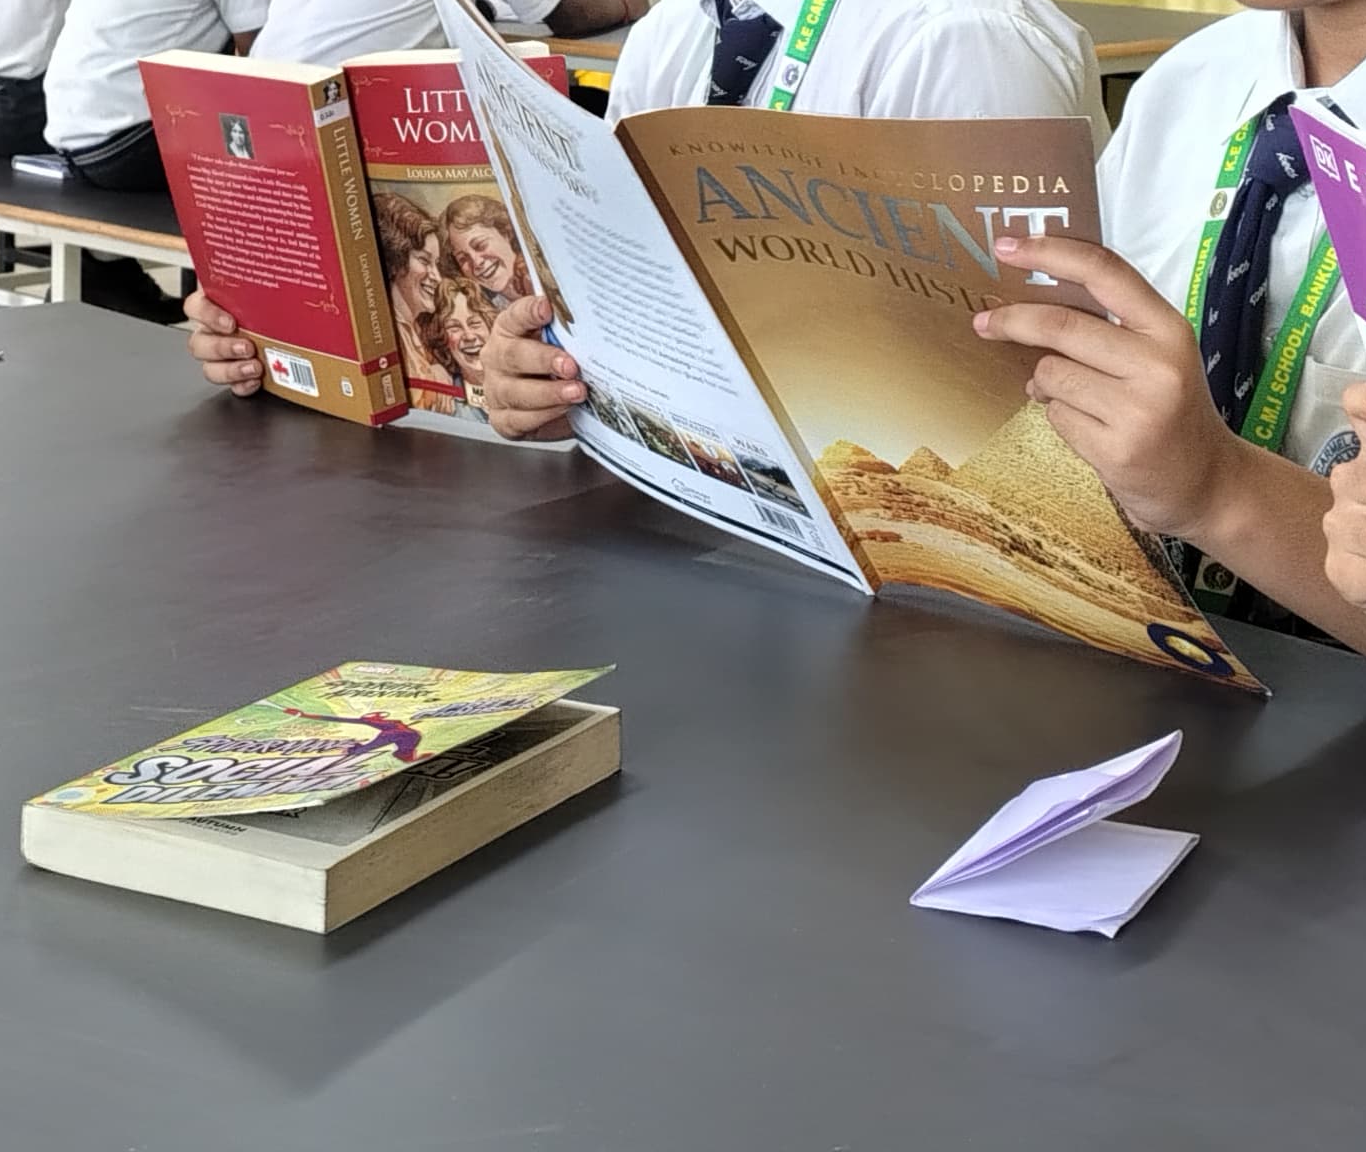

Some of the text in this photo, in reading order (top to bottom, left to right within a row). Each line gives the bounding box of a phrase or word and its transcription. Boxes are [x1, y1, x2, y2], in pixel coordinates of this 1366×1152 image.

[795, 26, 814, 52] K.E
[392, 116, 485, 144] WOM
[406, 167, 443, 179] LOUISA
[445, 167, 469, 179] MAY
[838, 160, 1071, 195] ENCLOPEDIA
[1223, 145, 1241, 173] K.E
[1315, 144, 1334, 171] DK
[332, 125, 364, 241] LITTLE WOMEN
[695, 164, 1071, 287] ANCIENT
[713, 234, 1005, 315] WORLD HISTO
[1187, 236, 1213, 321] BANKURA
[359, 252, 383, 345] LOUISA MAY ALCOTT
[1271, 320, 1309, 397] SCHOOL,
[1255, 397, 1289, 442] C.M.I
[103, 749, 392, 786] SOCIAL
